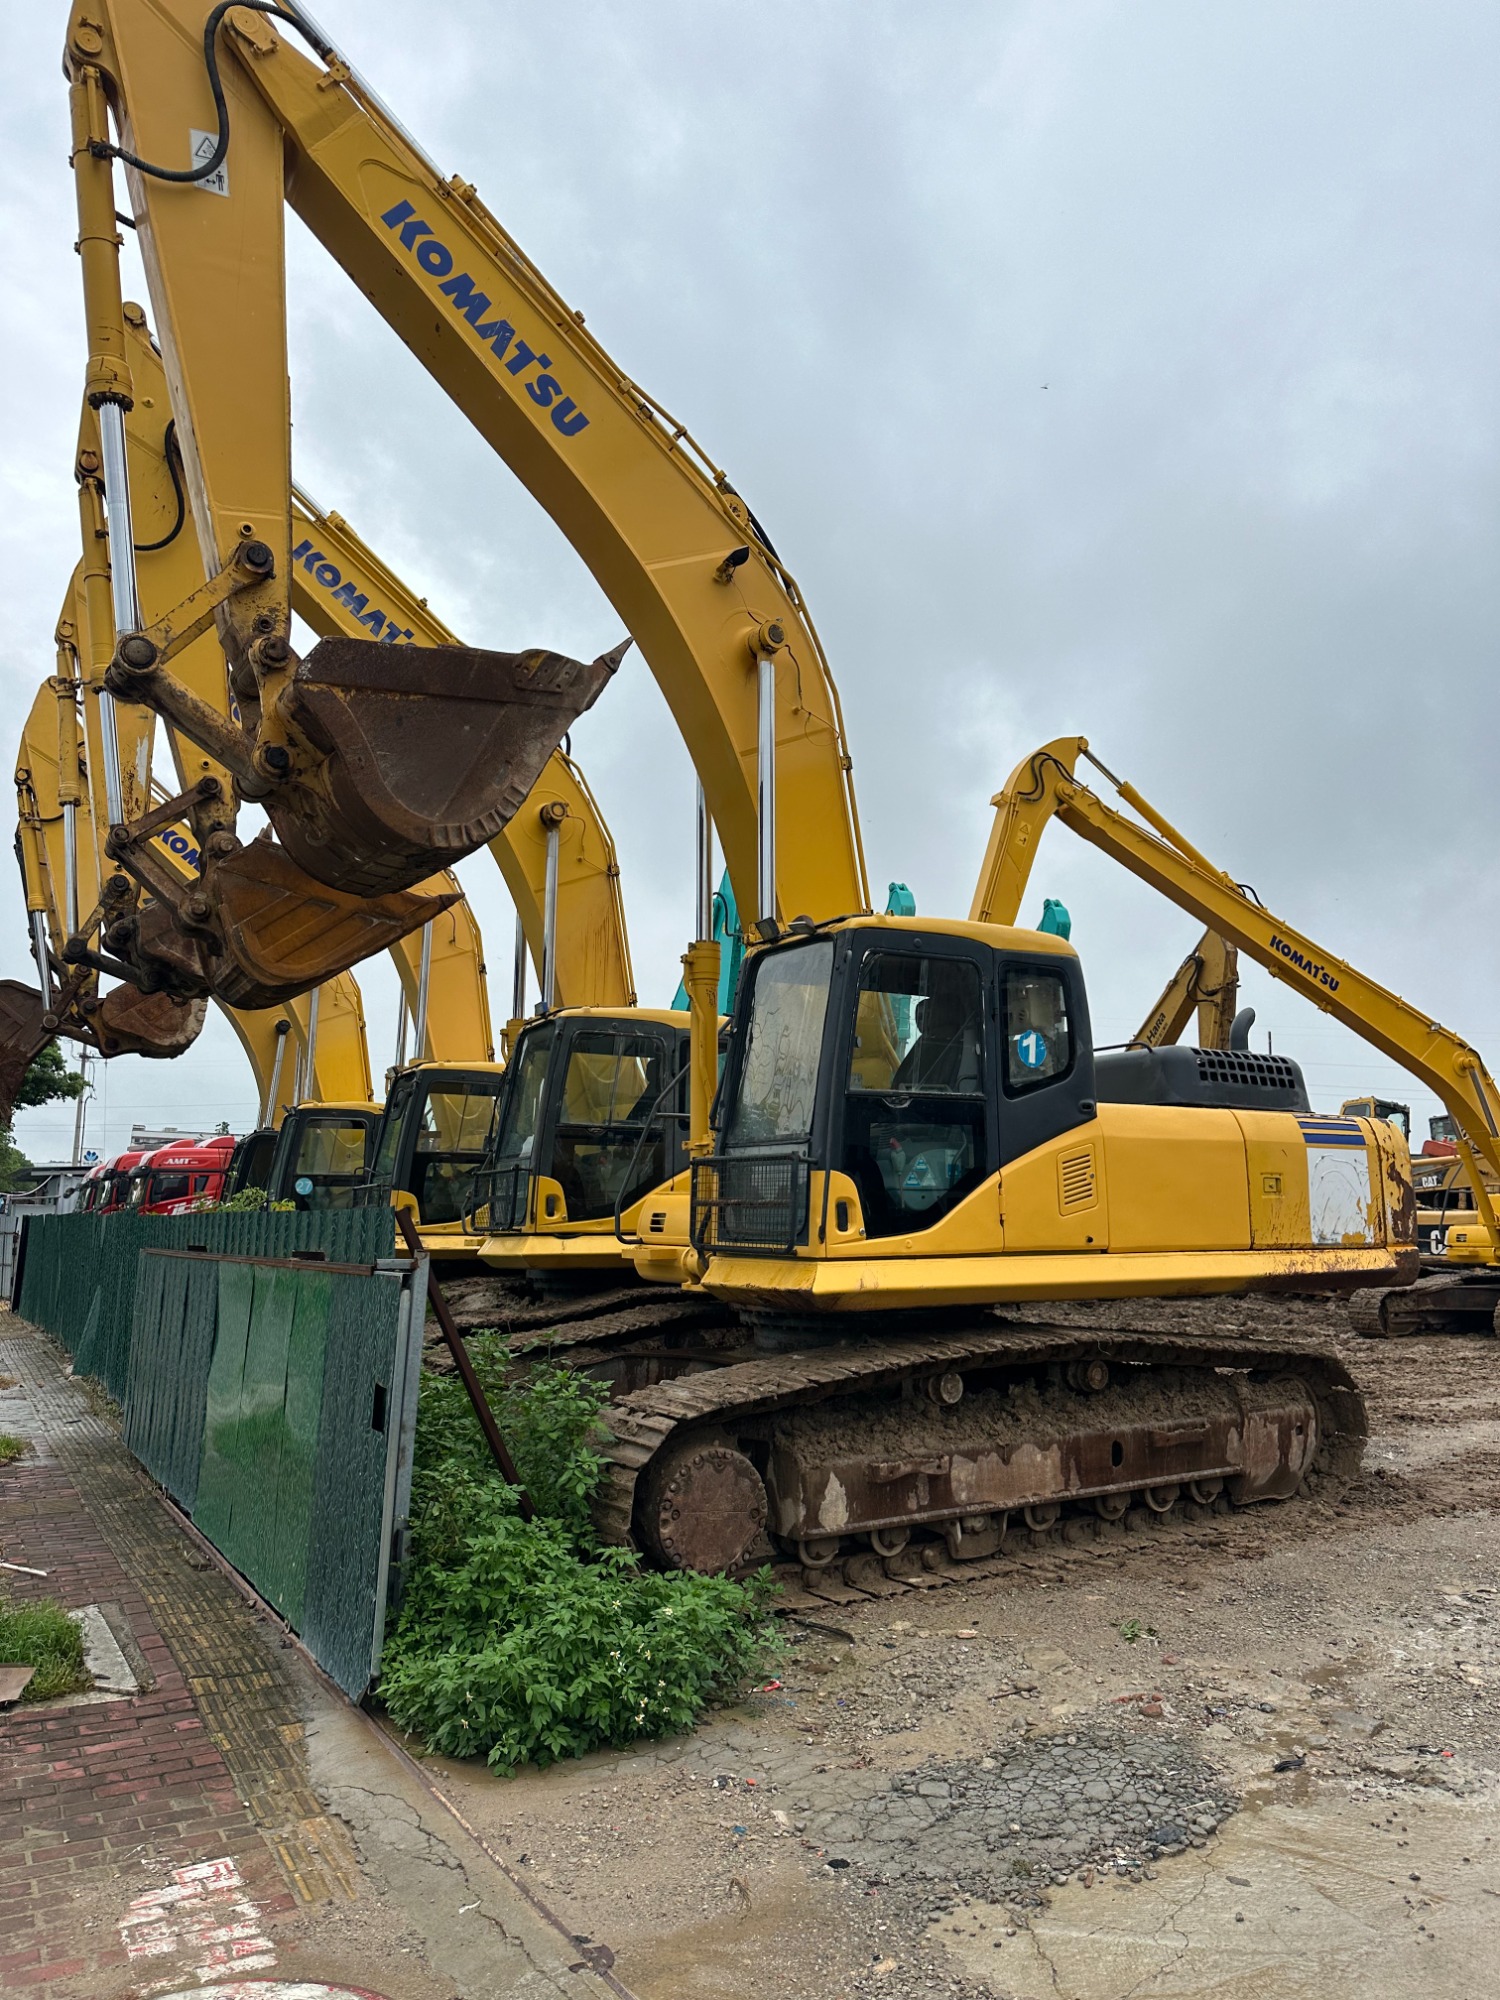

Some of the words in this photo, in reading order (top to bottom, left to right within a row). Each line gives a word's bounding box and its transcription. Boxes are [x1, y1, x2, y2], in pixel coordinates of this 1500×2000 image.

[380, 199, 590, 437] KOMATSU
[292, 539, 416, 648] KOMAT
[1269, 934, 1340, 992] KOMATSU
[1022, 1033, 1037, 1064] 1
[296, 1181, 312, 1192] 27
[1422, 1175, 1438, 1188] CAT
